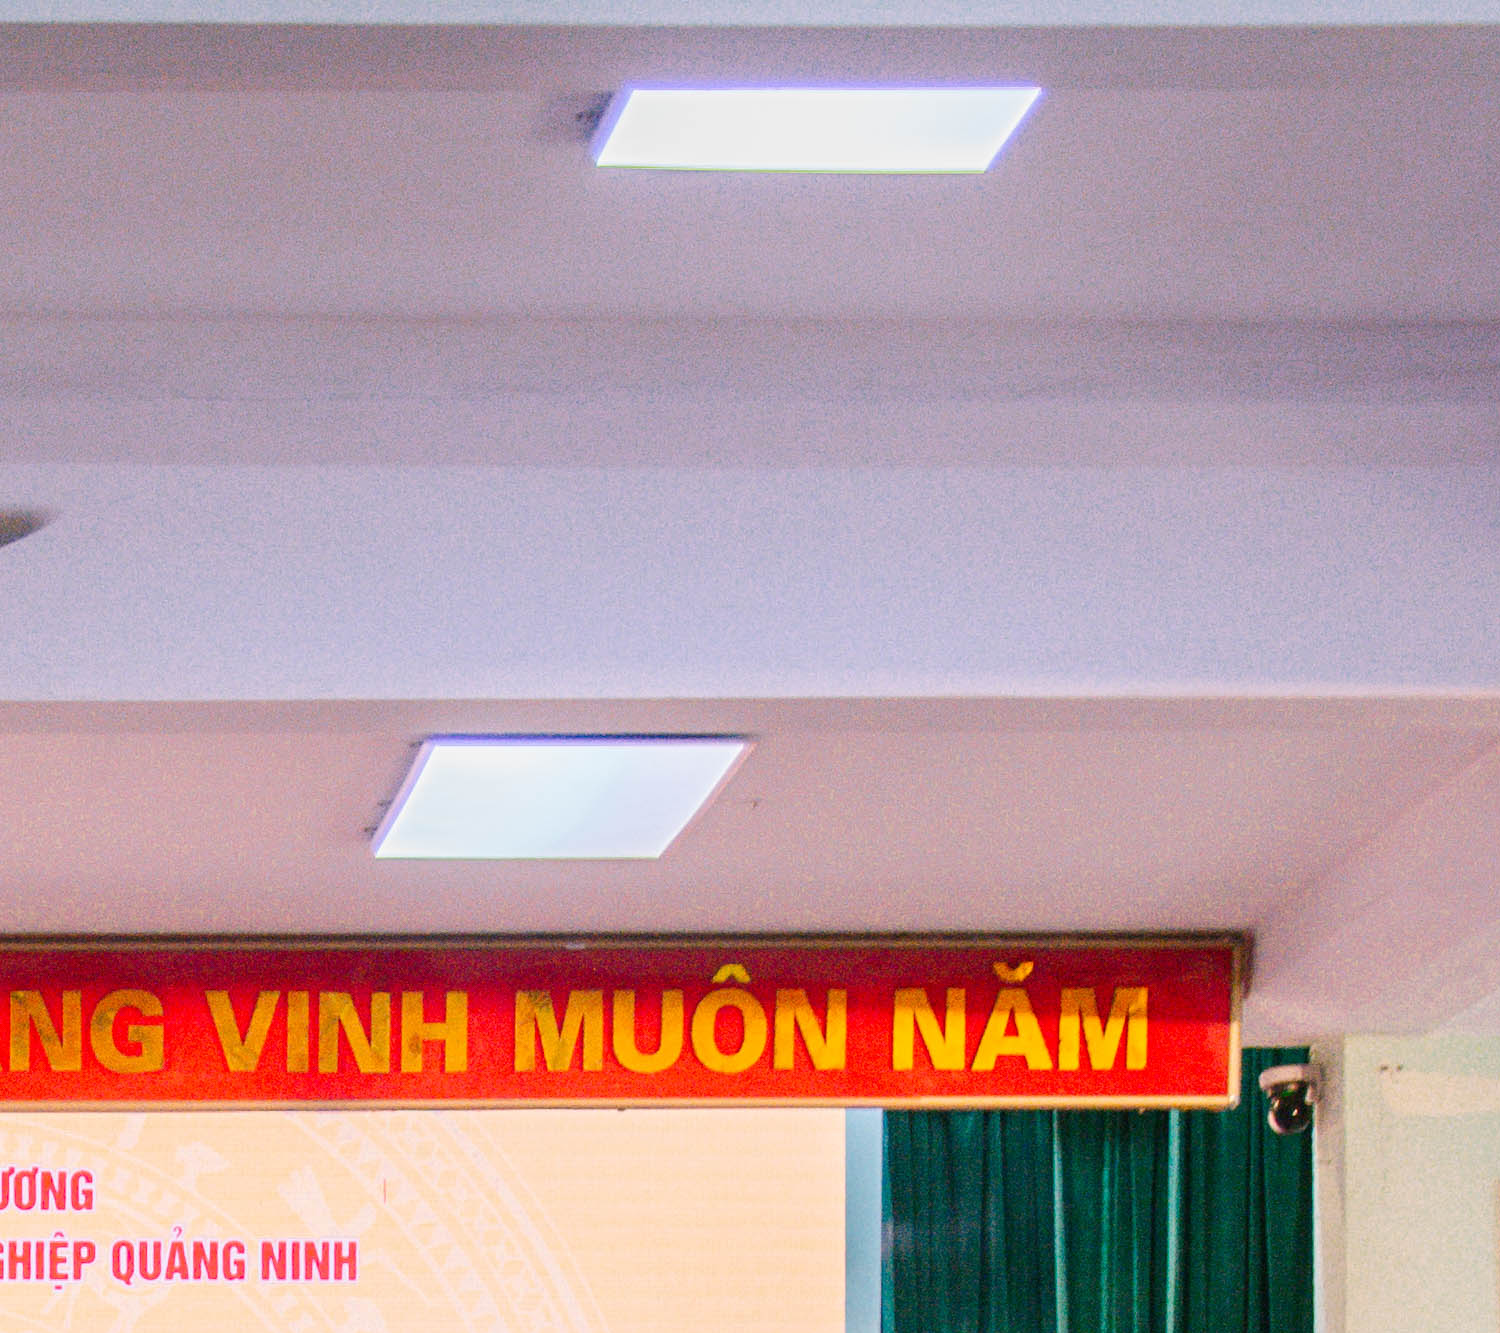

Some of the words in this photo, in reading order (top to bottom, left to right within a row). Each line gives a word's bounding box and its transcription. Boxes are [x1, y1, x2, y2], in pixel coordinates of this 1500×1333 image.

[208, 992, 467, 1073] VINH
[515, 964, 846, 1074] MUÔN
[893, 963, 1147, 1071] NĂM
[112, 1228, 245, 1285] QUẢNG
[262, 1242, 356, 1280] NINH
